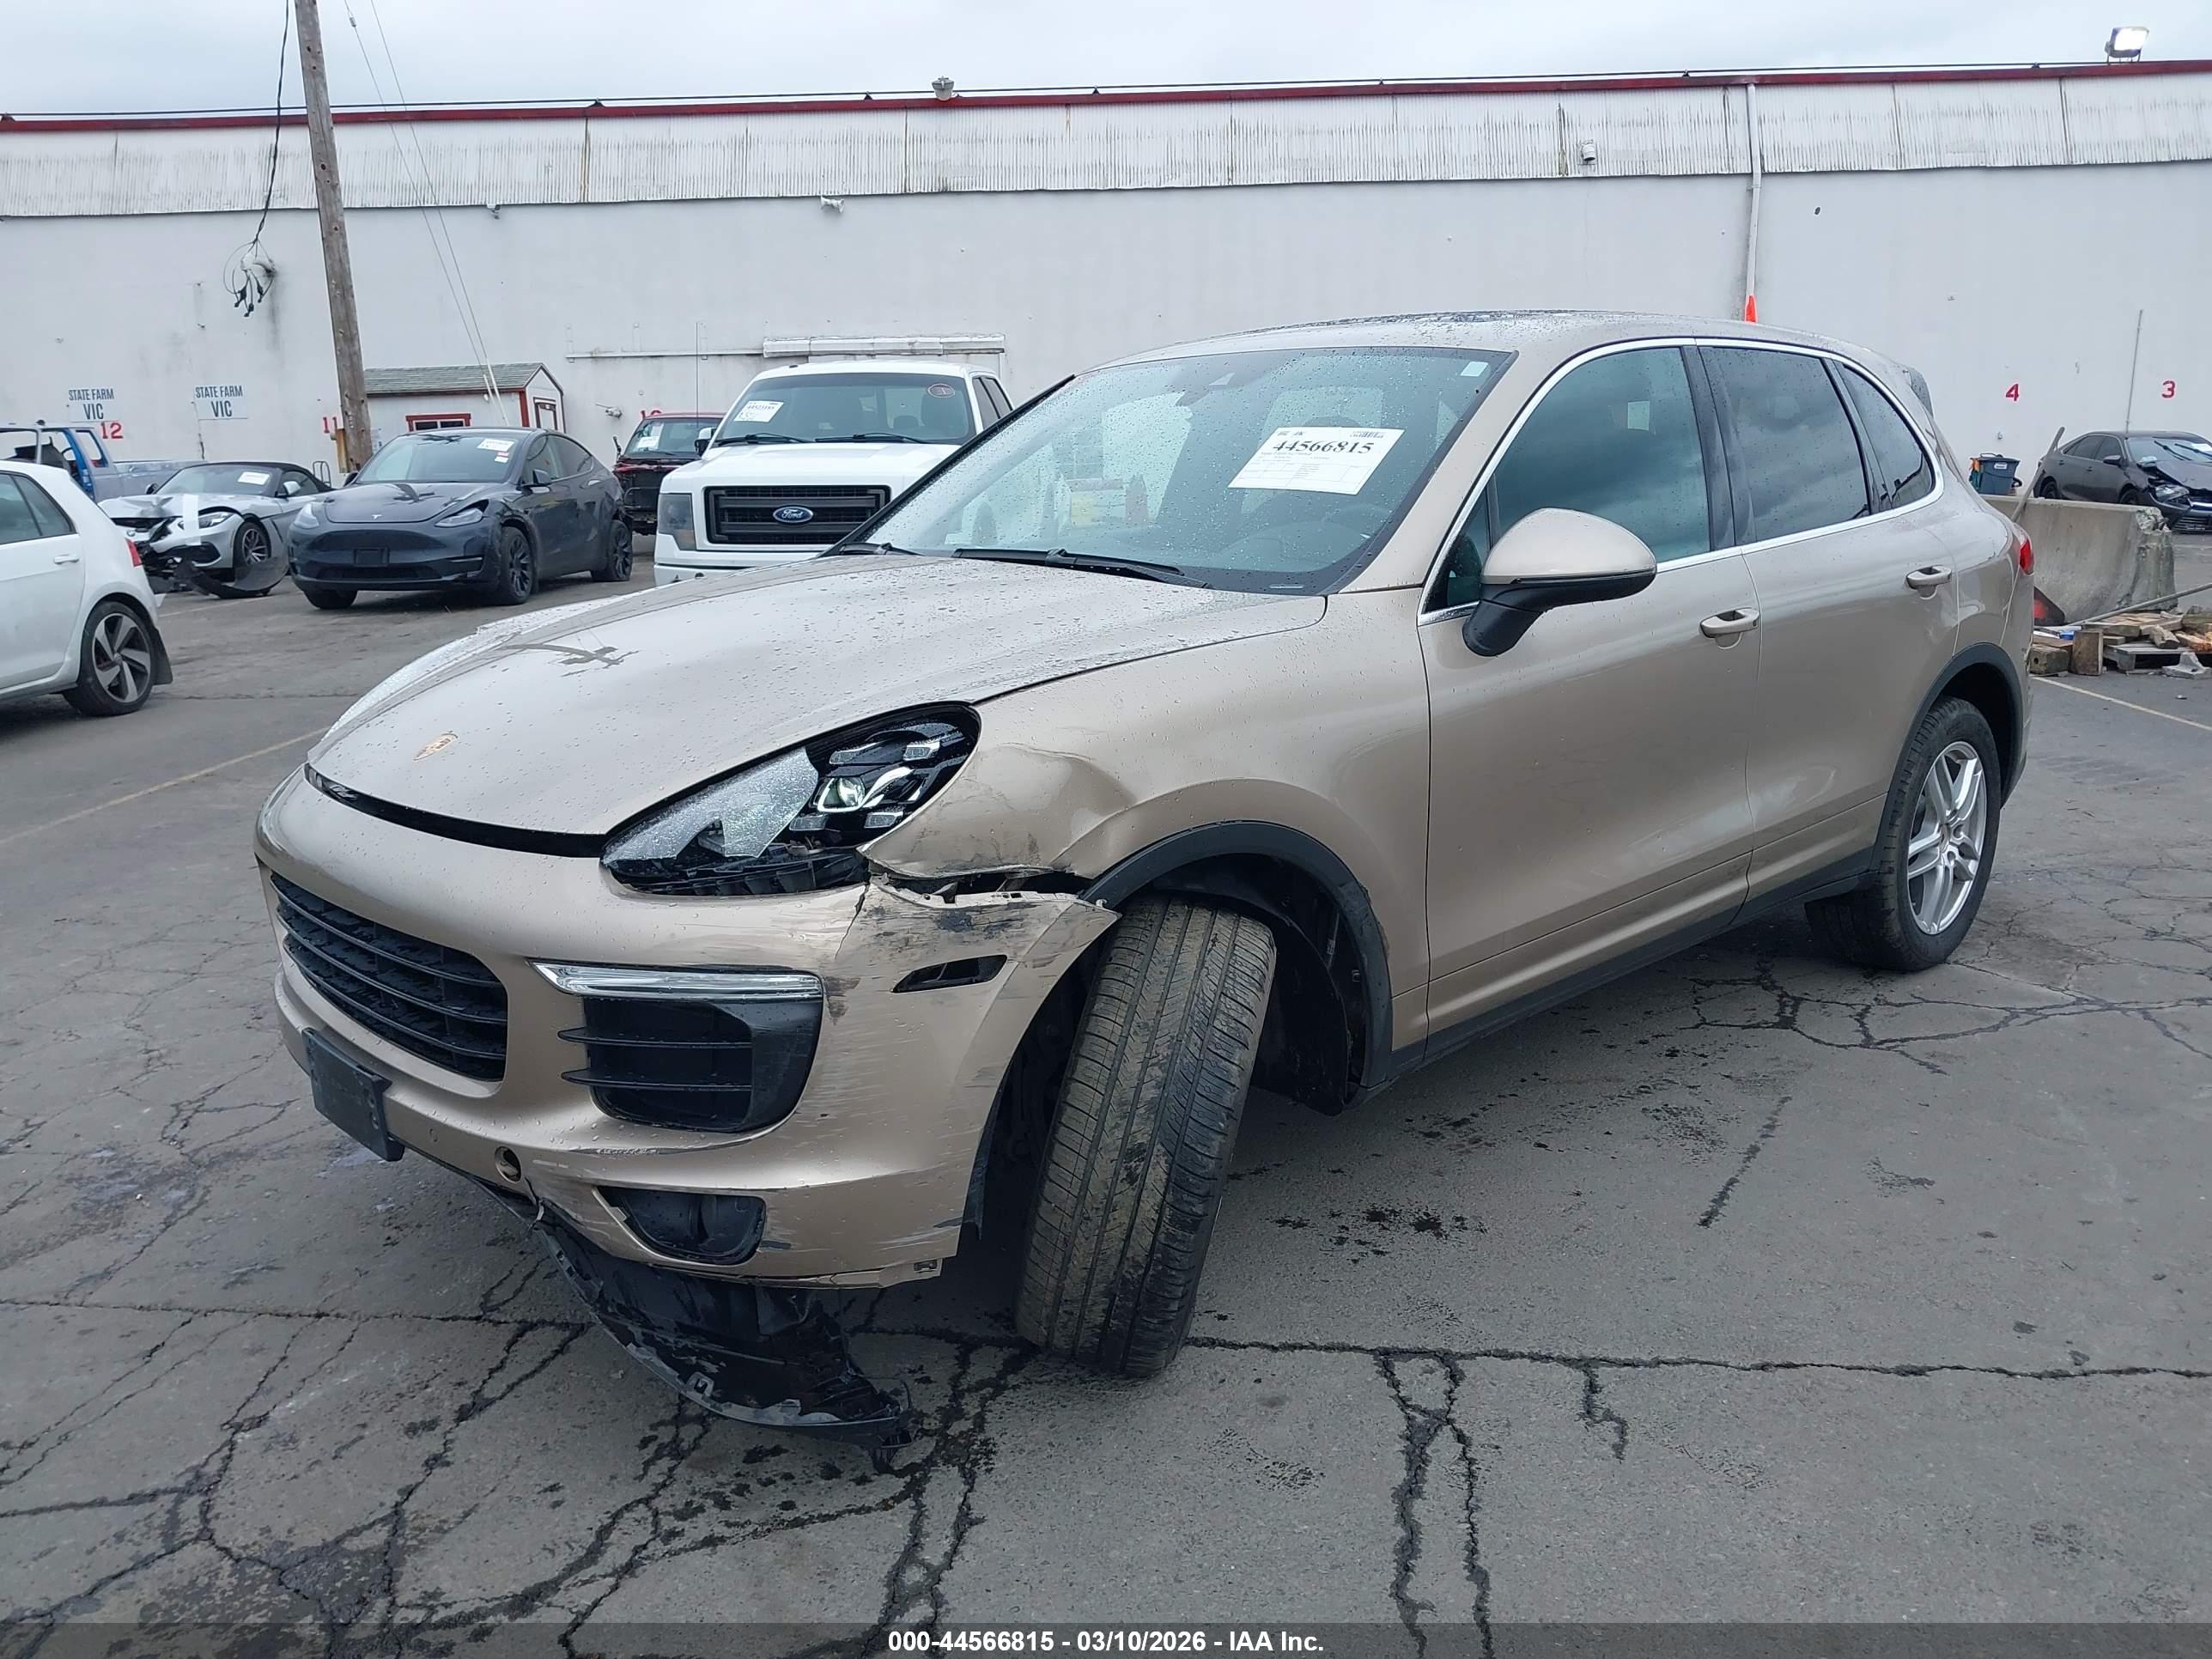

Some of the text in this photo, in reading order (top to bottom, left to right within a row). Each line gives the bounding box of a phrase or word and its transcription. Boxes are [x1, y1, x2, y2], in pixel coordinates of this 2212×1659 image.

[69, 388, 114, 401] STATE FARM
[196, 386, 243, 398] STATE FARM
[2005, 384, 2020, 402] 4
[2161, 380, 2176, 398] 3
[83, 404, 104, 420] VIC
[210, 400, 233, 417] VIC
[100, 422, 124, 439] 12
[1273, 441, 1374, 454] 44566815
[781, 508, 804, 519] Ford
